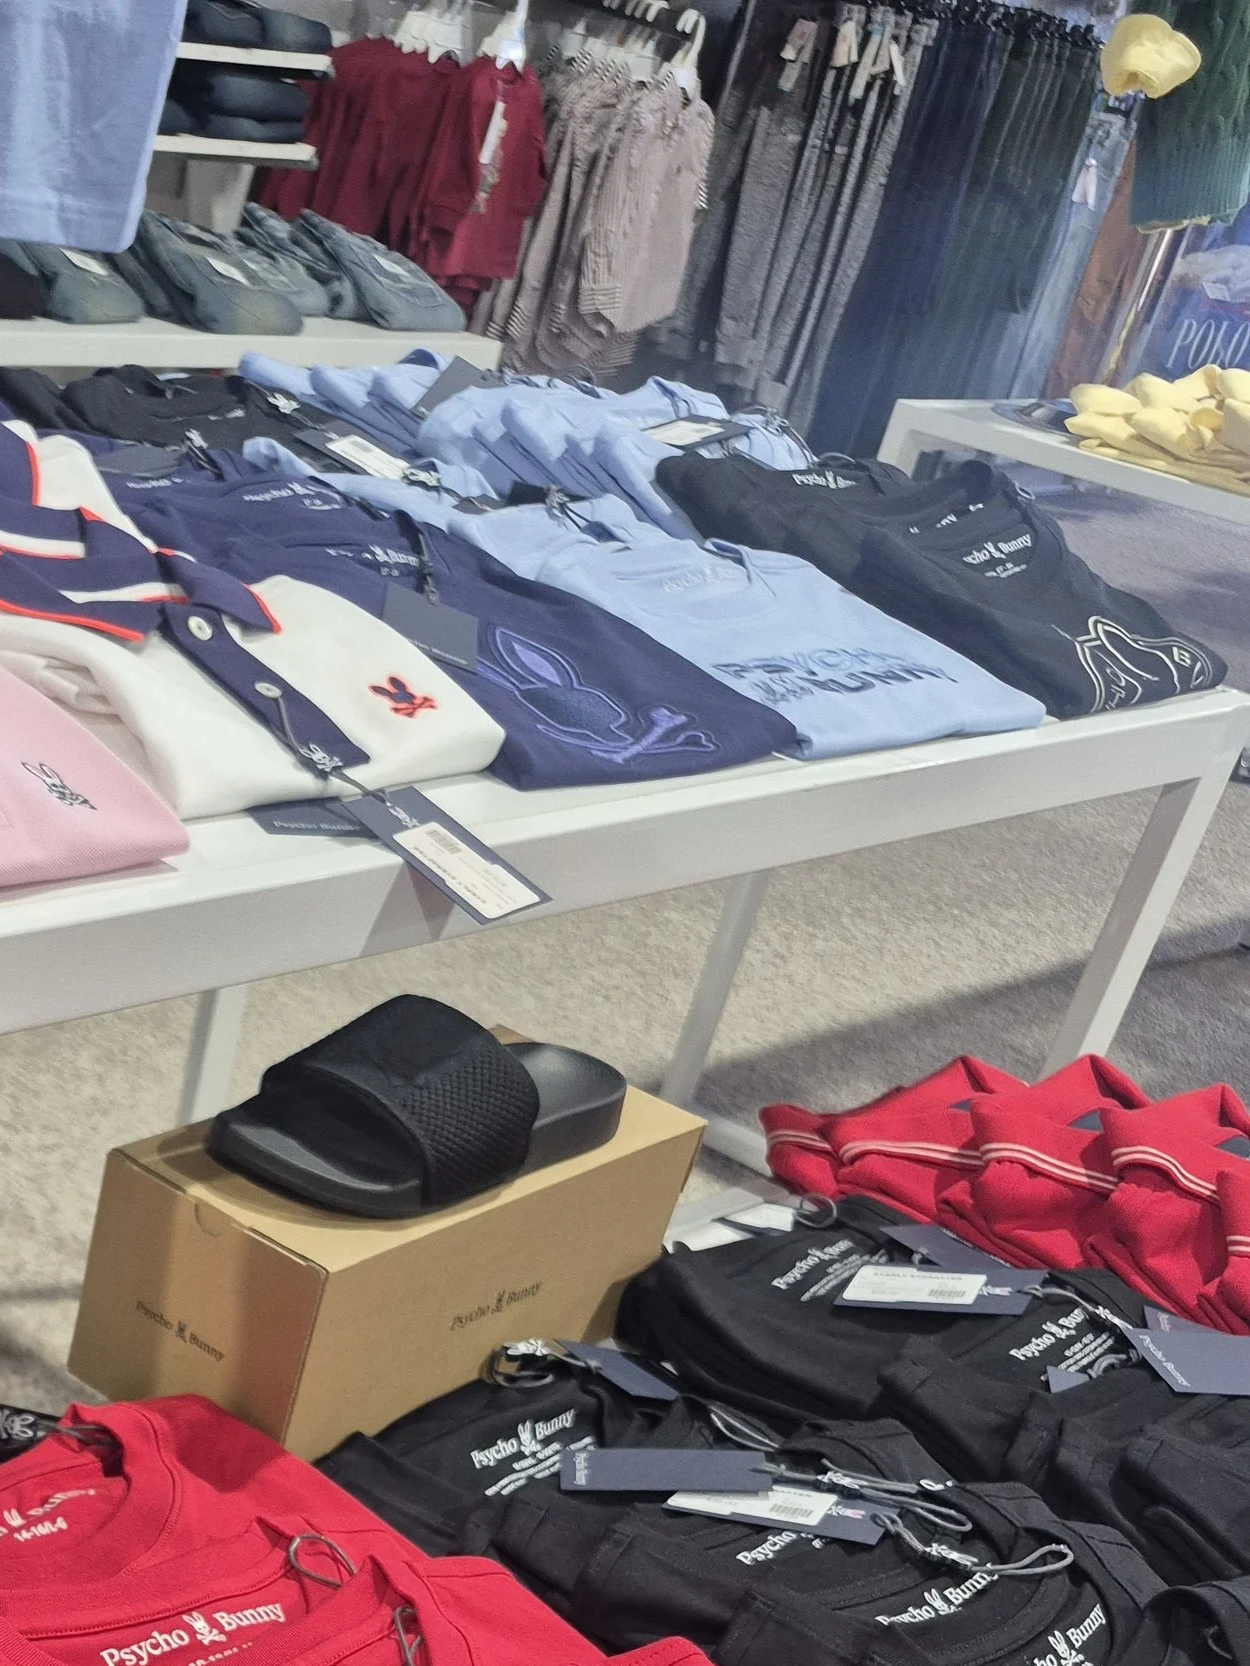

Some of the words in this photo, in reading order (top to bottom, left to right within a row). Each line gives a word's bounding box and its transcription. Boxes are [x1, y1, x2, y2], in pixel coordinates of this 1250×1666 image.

[189, 1331, 225, 1362] Bunny
[1008, 1331, 1057, 1361] Psycho
[470, 1437, 520, 1469] Psycho
[534, 1408, 577, 1441] Bunny
[212, 1602, 286, 1630] Bunny
[1065, 1603, 1107, 1648] Bunny
